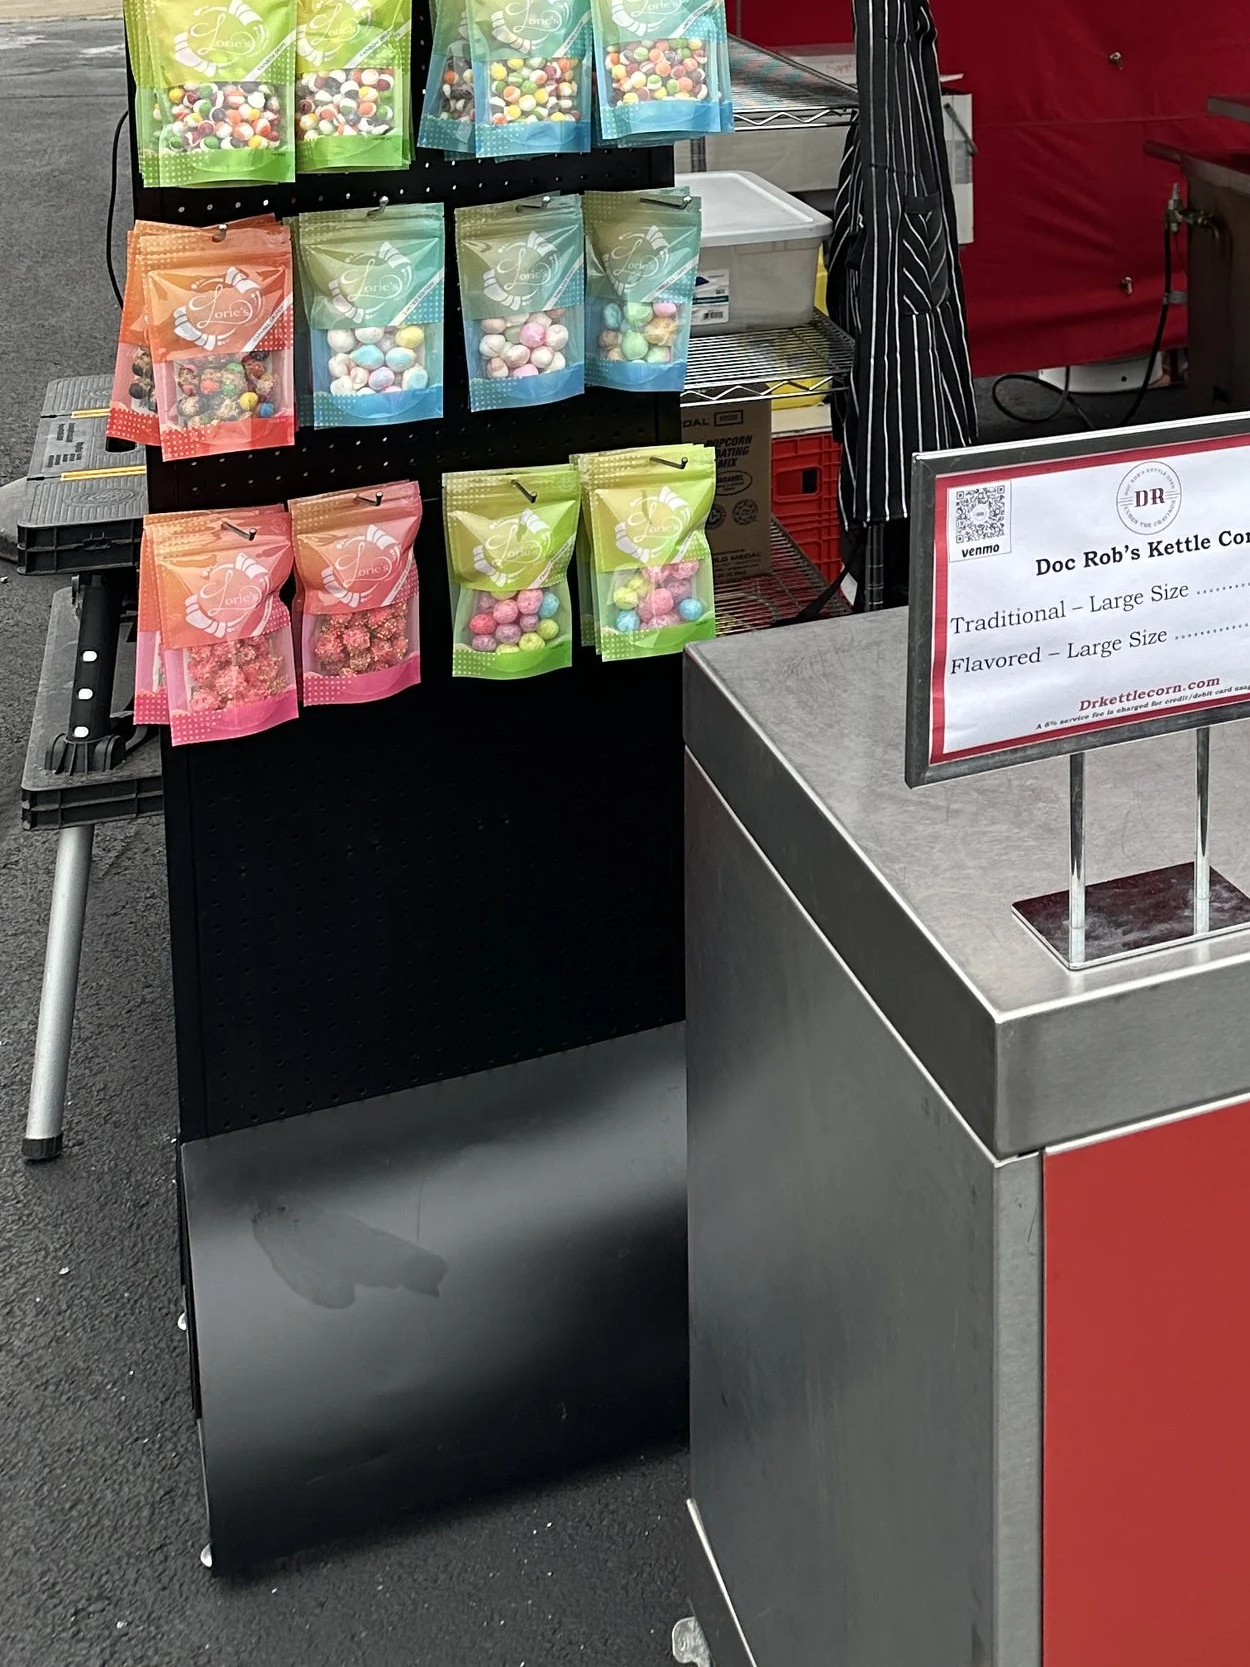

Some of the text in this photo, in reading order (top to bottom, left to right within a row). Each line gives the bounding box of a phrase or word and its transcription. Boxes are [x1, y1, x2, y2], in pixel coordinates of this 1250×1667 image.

[340, 259, 402, 302] Lorie's
[189, 284, 252, 328] Lorie's
[1134, 487, 1165, 508] DR
[335, 542, 392, 588] Lorie's
[961, 544, 1000, 558] venmo
[1035, 558, 1076, 576] Doc
[1083, 544, 1141, 568] Rob's
[1147, 534, 1211, 558] Kettle
[950, 600, 1067, 634] Traditional
[1090, 591, 1144, 612] Large
[1151, 583, 1189, 602] Size
[950, 646, 1041, 674] Flavored
[1067, 639, 1122, 659] Large
[1129, 629, 1168, 648] Size
[1059, 714, 1090, 725] service
[1092, 711, 1105, 719] fee
[1116, 702, 1149, 714] charged
[1151, 698, 1163, 707] for
[1164, 690, 1213, 706] credit/debit
[1214, 686, 1232, 695] card
[1079, 677, 1220, 712] Drkettlecorn.com
